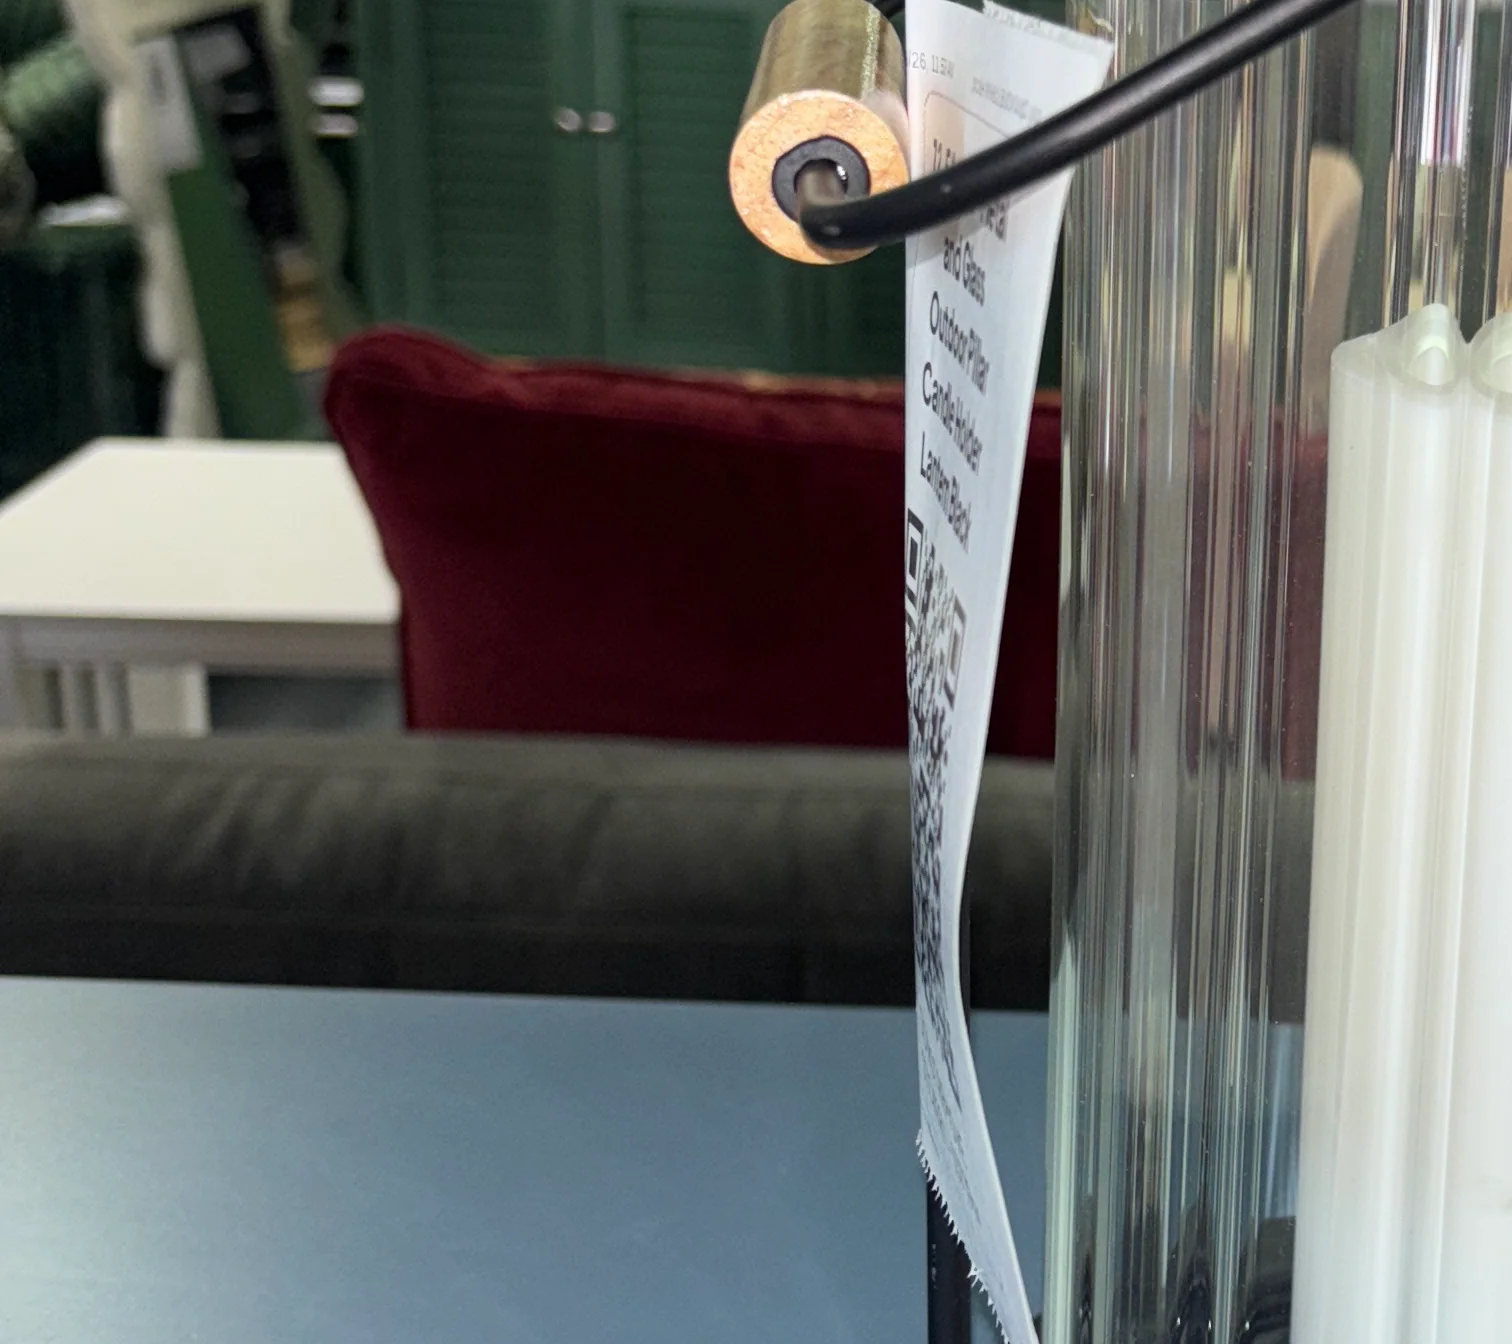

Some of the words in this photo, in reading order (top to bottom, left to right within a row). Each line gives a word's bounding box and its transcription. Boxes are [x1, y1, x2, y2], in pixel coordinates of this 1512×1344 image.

[944, 235, 962, 281] and
[963, 241, 985, 307] Glass
[930, 291, 968, 369] Outdoor
[966, 328, 990, 396] Pillar
[923, 362, 954, 436] Candle
[953, 397, 982, 475] Holder
[921, 431, 949, 516] Lantern
[948, 476, 971, 554] Black
